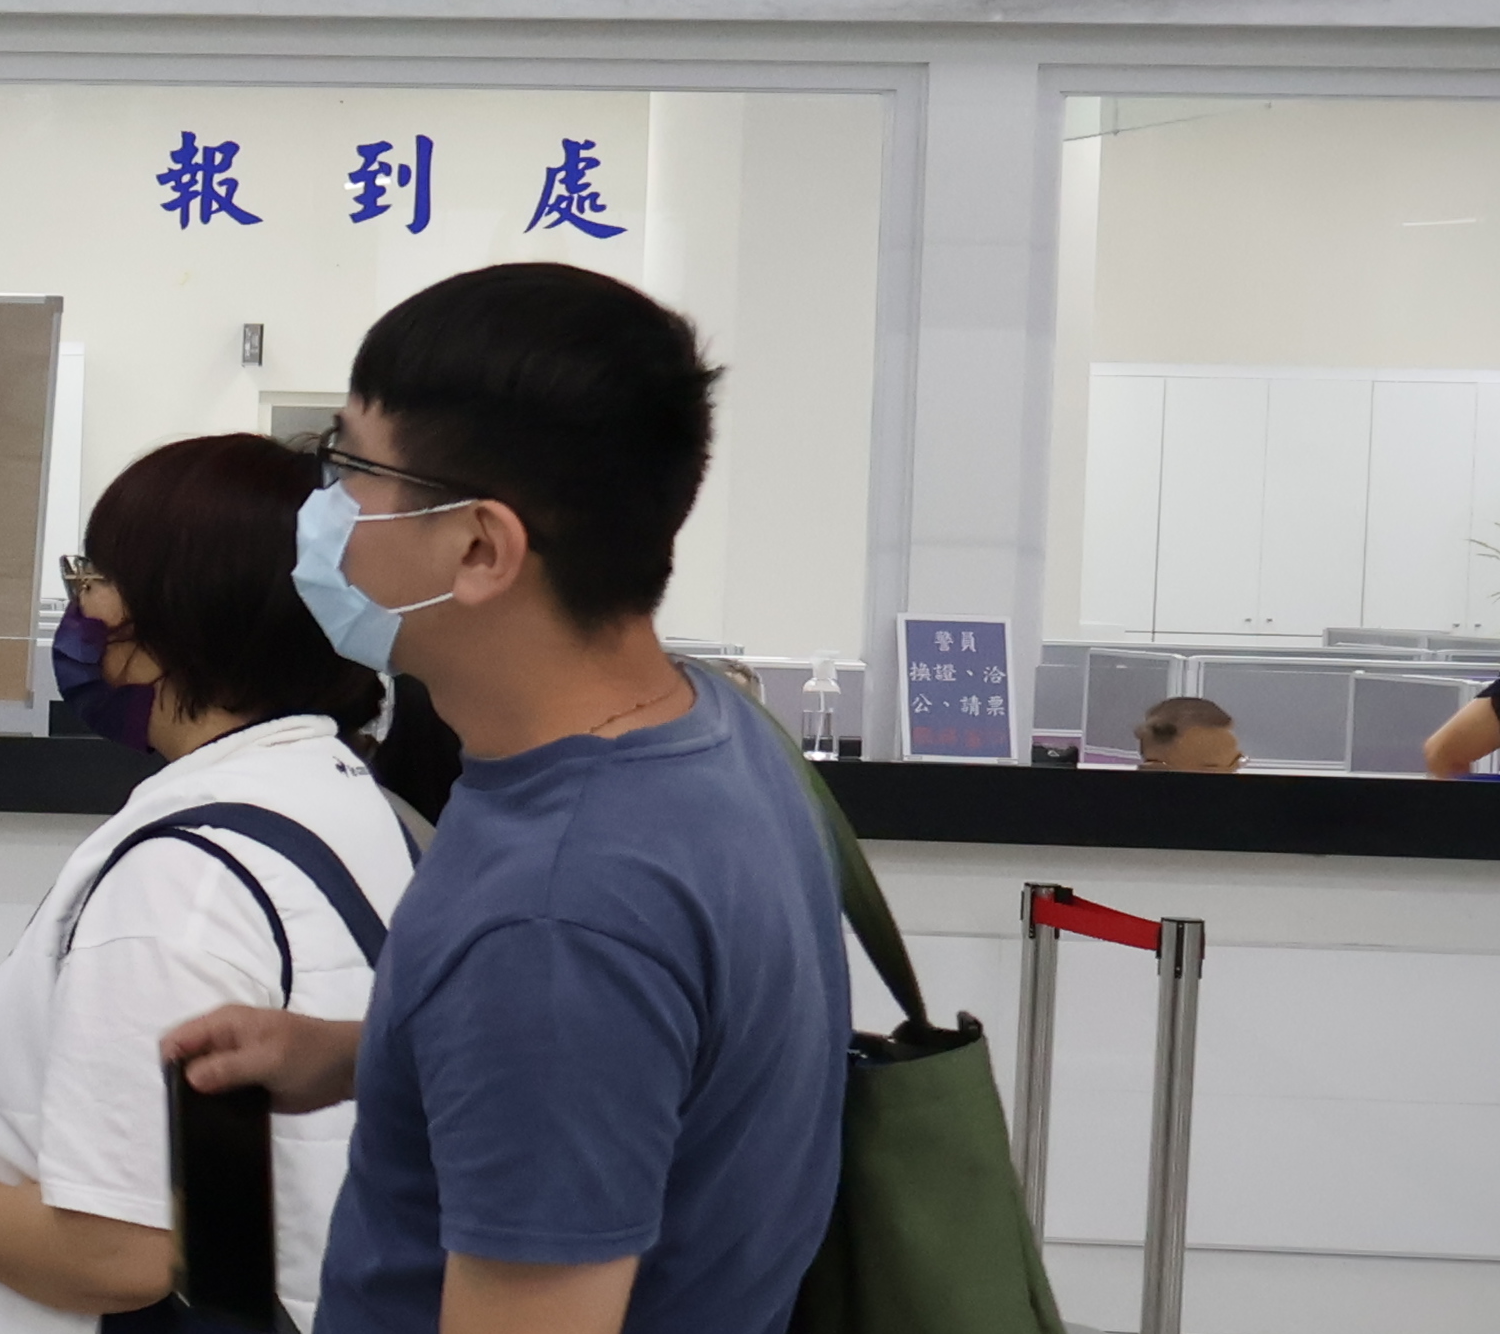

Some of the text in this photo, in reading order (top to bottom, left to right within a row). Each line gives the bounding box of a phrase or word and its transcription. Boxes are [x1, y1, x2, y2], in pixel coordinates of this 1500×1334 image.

[156, 130, 627, 240] 報到處
[934, 630, 977, 652] 警員
